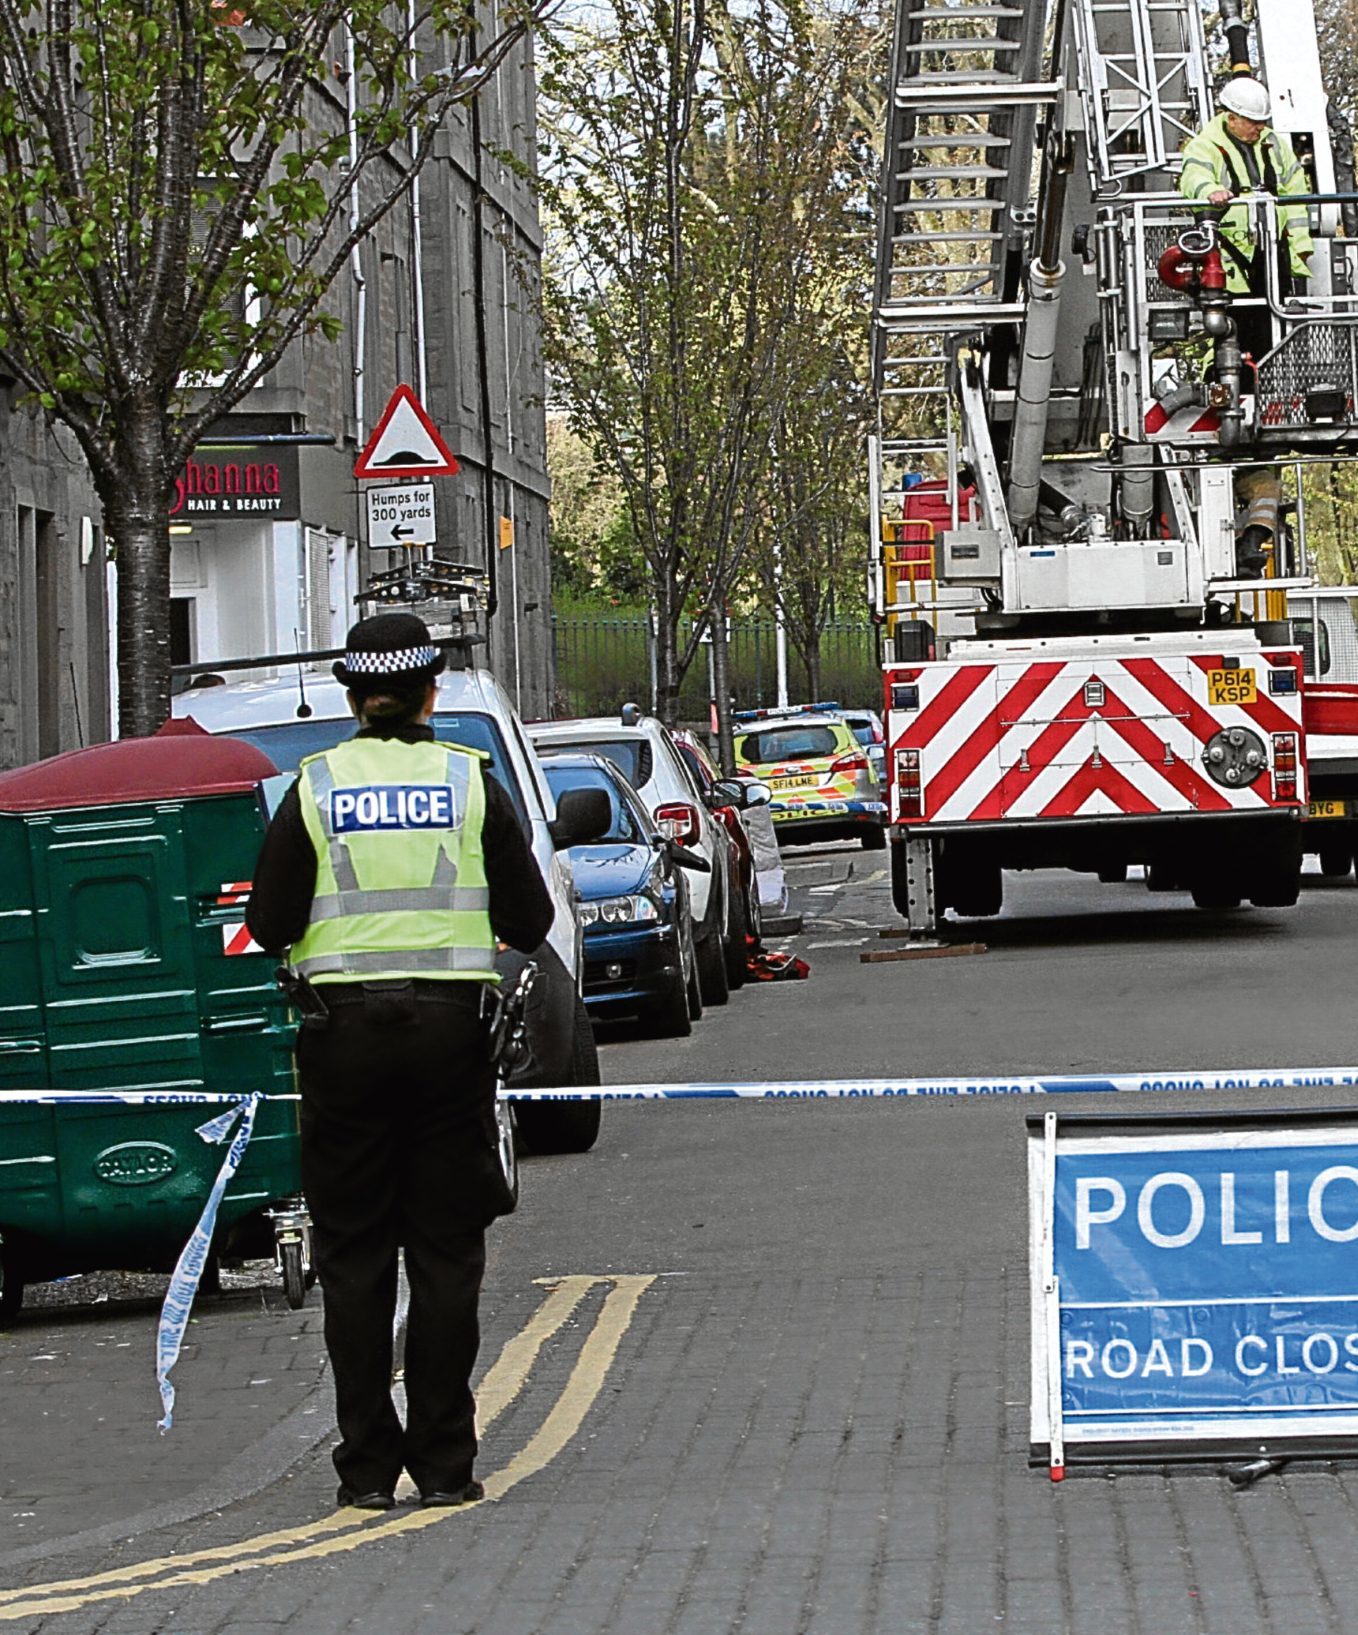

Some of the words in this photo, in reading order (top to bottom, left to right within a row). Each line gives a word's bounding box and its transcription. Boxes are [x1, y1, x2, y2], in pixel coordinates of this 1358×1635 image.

[188, 499, 216, 511] HAIR
[222, 499, 231, 511] &
[237, 498, 281, 511] BEAUTY
[372, 492, 410, 508] Humps
[413, 490, 431, 503] for
[372, 507, 397, 520] 300
[400, 506, 431, 521] yards
[1212, 671, 1252, 687] P614
[1216, 687, 1250, 703] KSP
[773, 779, 793, 789] SF14
[335, 788, 452, 830] POLICE
[1066, 1338, 1213, 1380] ROAD
